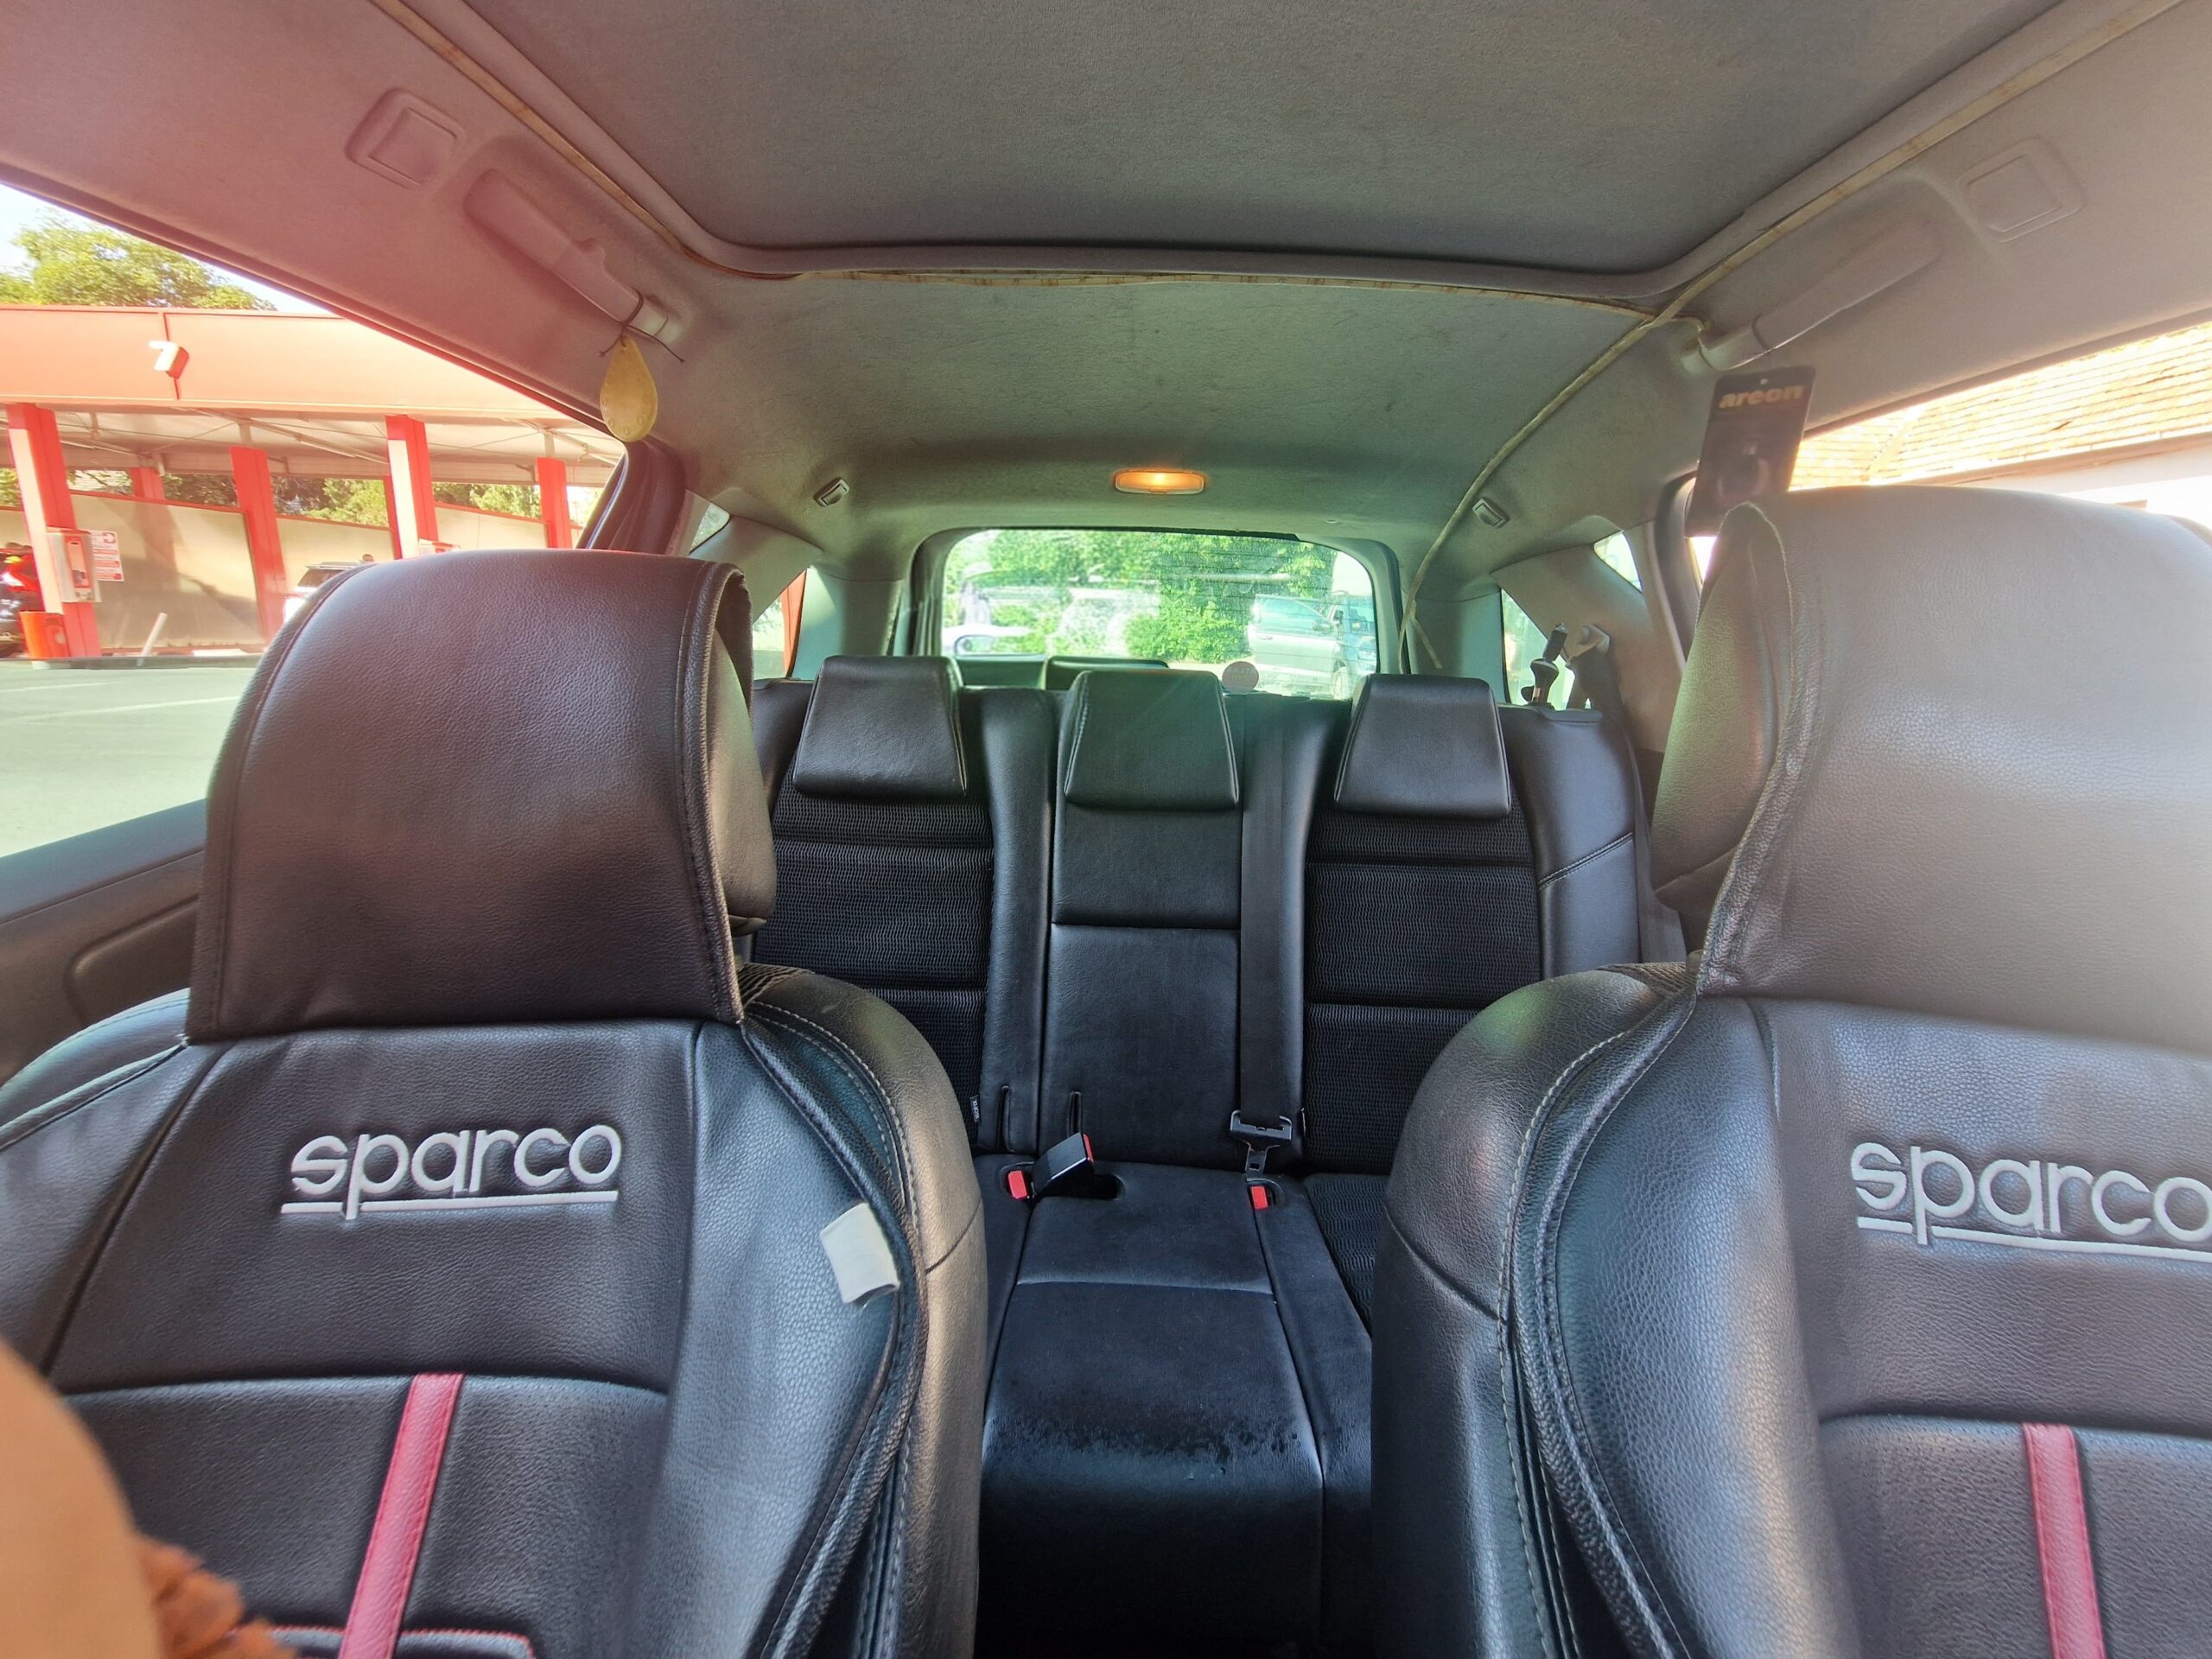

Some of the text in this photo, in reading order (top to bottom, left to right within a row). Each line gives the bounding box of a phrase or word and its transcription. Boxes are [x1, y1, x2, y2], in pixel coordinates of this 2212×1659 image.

[1719, 385, 1805, 409] areon
[290, 1124, 622, 1220] sparco
[1850, 1141, 2212, 1245] sparco
